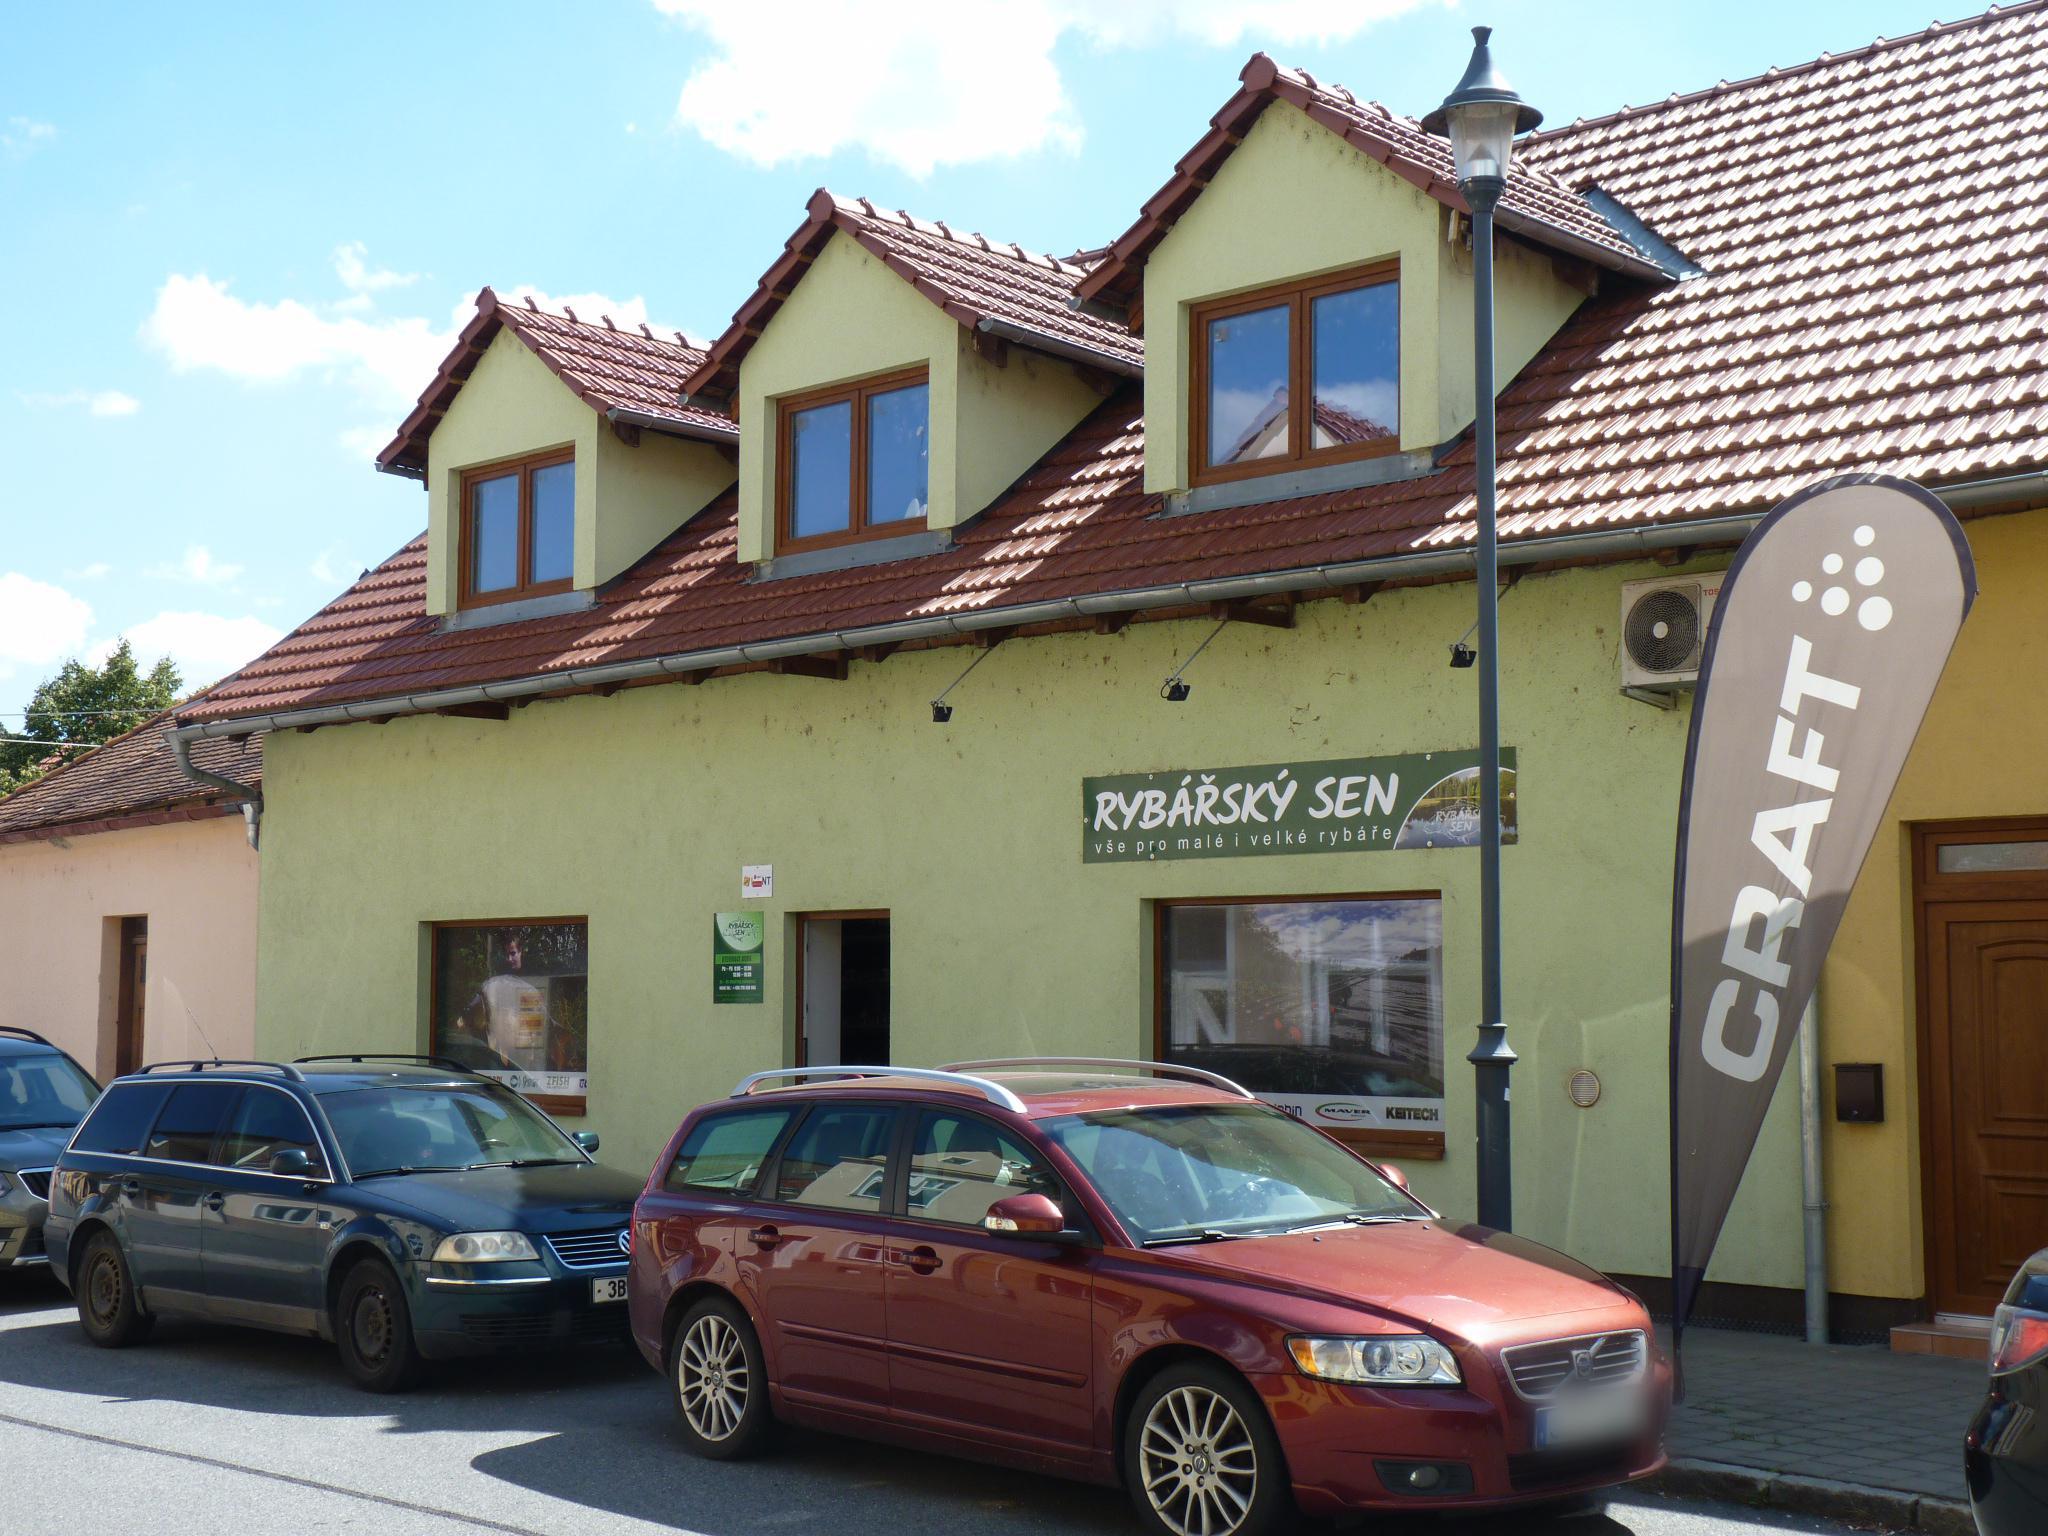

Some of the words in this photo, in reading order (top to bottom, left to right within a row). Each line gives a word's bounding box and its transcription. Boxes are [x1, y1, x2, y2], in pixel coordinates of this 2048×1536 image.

[1093, 768, 1298, 832] RYBÁŘSKÝ
[1308, 773, 1399, 819] SEN
[1436, 806, 1480, 821] RYBÁŘS
[1449, 821, 1472, 832] SEN
[1095, 838, 1126, 854] vše
[1136, 838, 1167, 855] pro
[1177, 832, 1224, 850] malé
[1250, 828, 1308, 846] velké
[1319, 825, 1392, 846] rybáře
[1701, 634, 1862, 1083] CRAFT
[1324, 1107, 1371, 1115] MAVER
[1385, 1106, 1439, 1120] KEITECH
